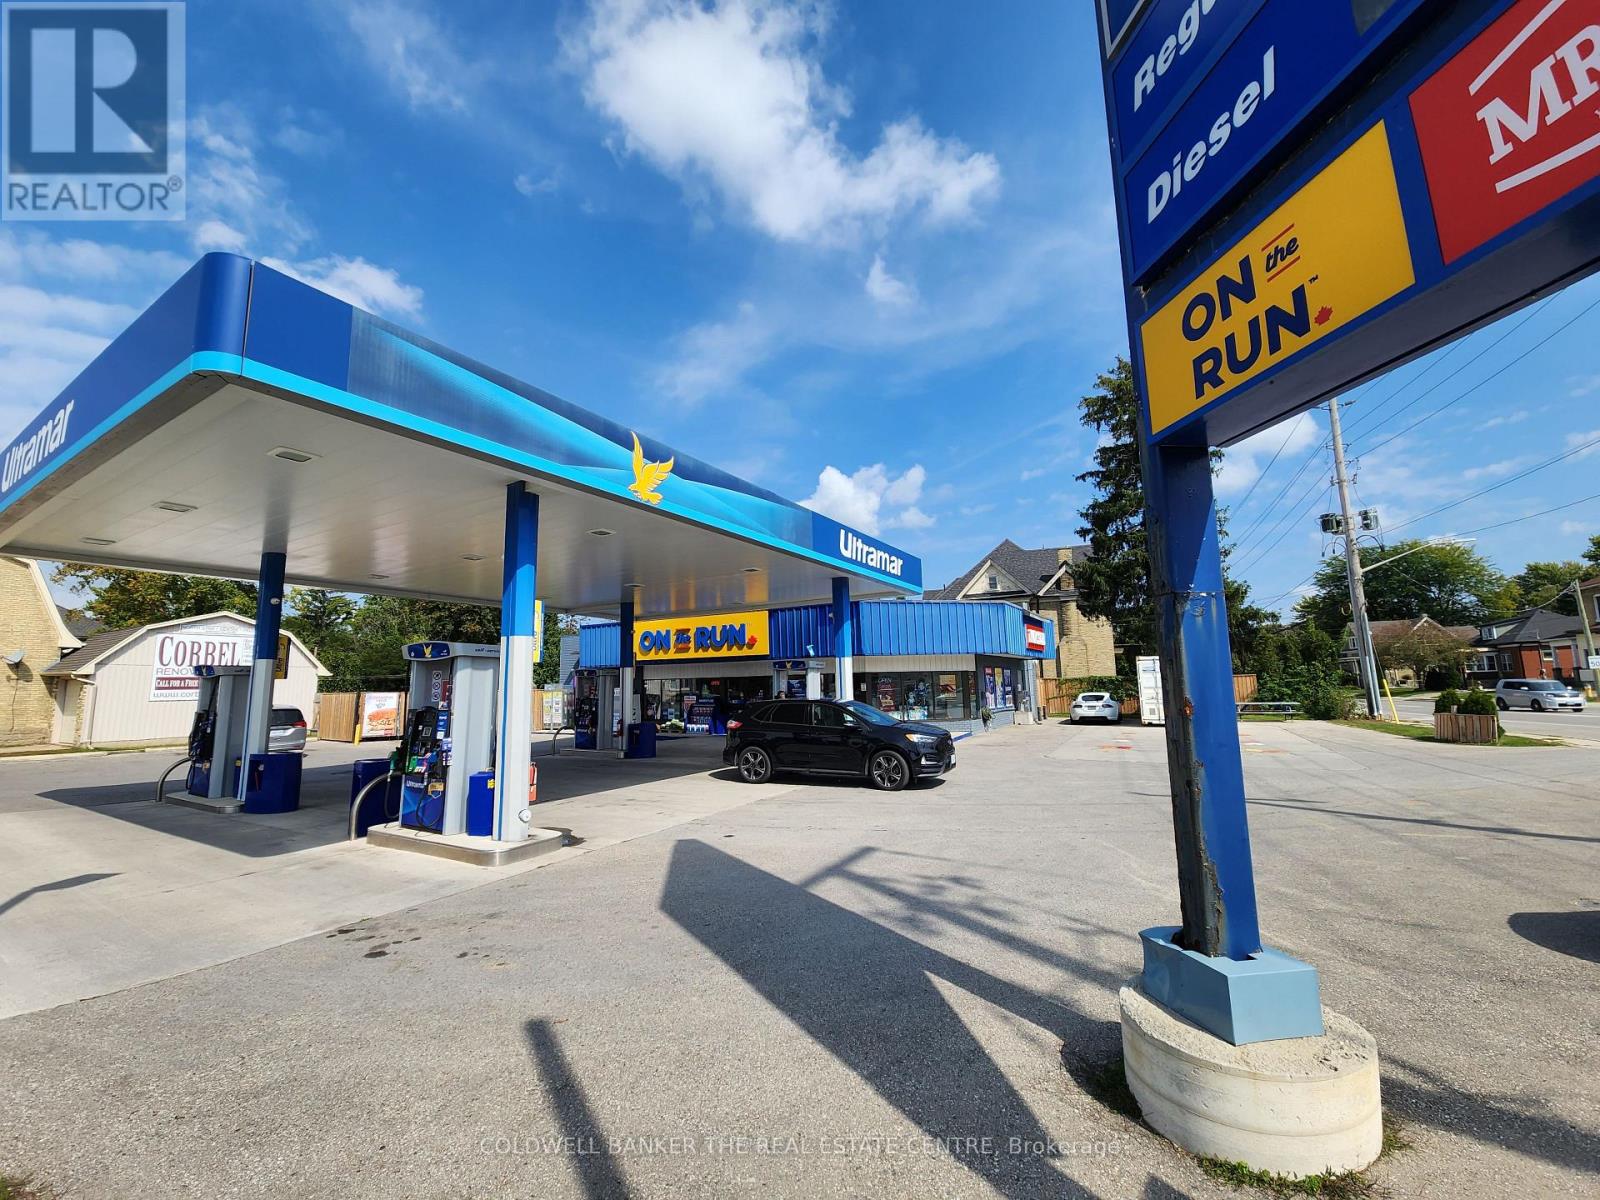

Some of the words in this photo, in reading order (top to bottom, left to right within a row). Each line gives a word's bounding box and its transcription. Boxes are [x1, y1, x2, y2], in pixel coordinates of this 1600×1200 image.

[1148, 45, 1274, 224] Diesel
[1182, 254, 1257, 341] ON
[1265, 237, 1299, 272] the
[1192, 283, 1311, 400] RUN
[1, 399, 75, 493] Ultramar
[840, 528, 904, 576] Ultramar
[158, 636, 240, 667] CORBEL
[640, 628, 671, 652] ON
[675, 631, 692, 644] the
[695, 623, 747, 650] RUN
